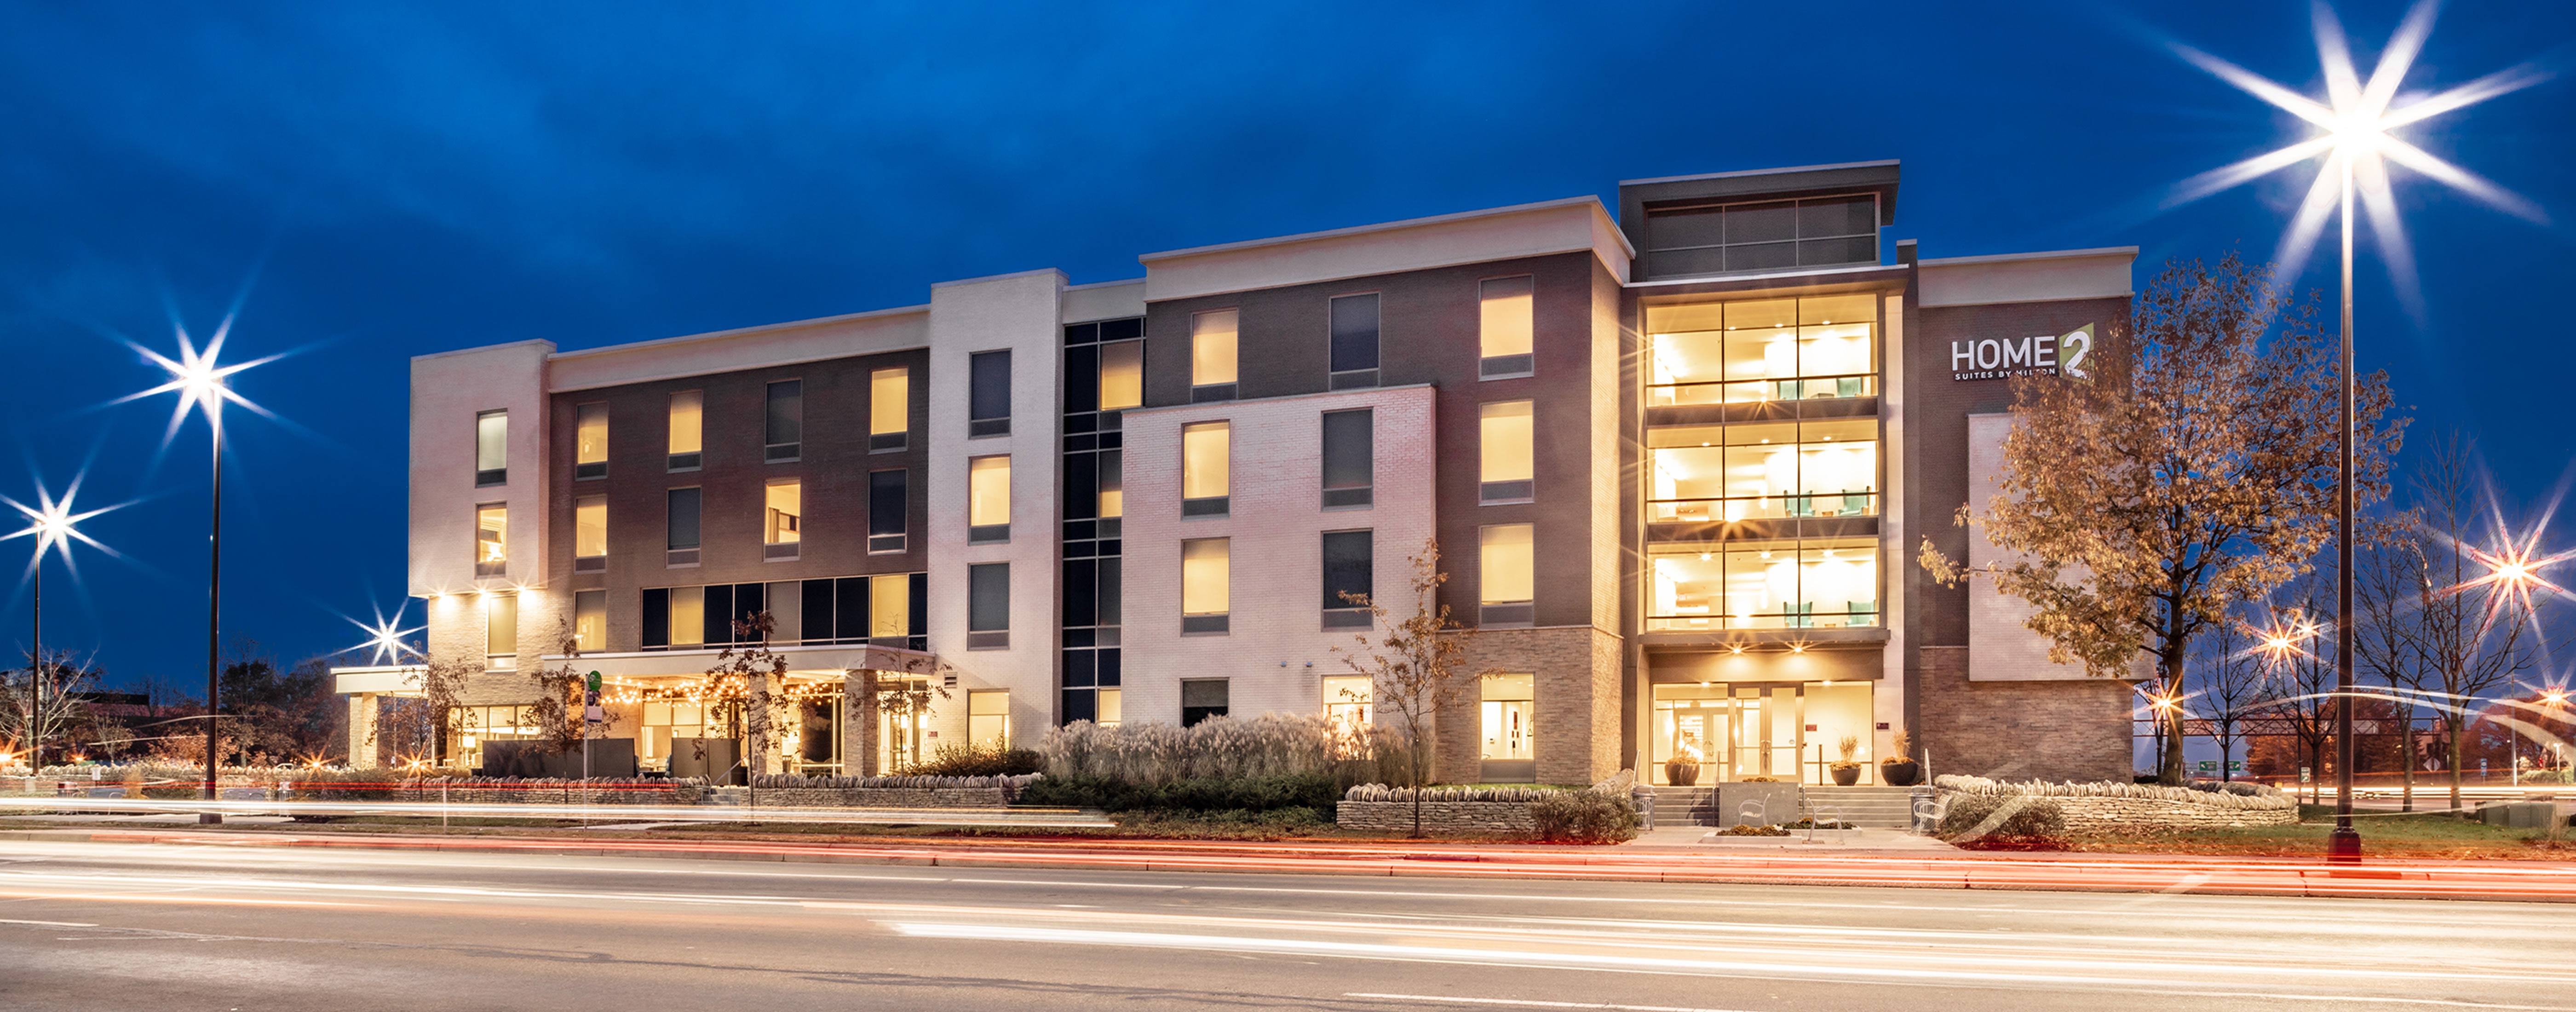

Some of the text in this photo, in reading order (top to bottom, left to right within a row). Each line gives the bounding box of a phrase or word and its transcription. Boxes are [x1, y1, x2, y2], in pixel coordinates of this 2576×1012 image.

[1952, 331, 2091, 380] HOME 2
[1955, 371, 1993, 380] SUITES
